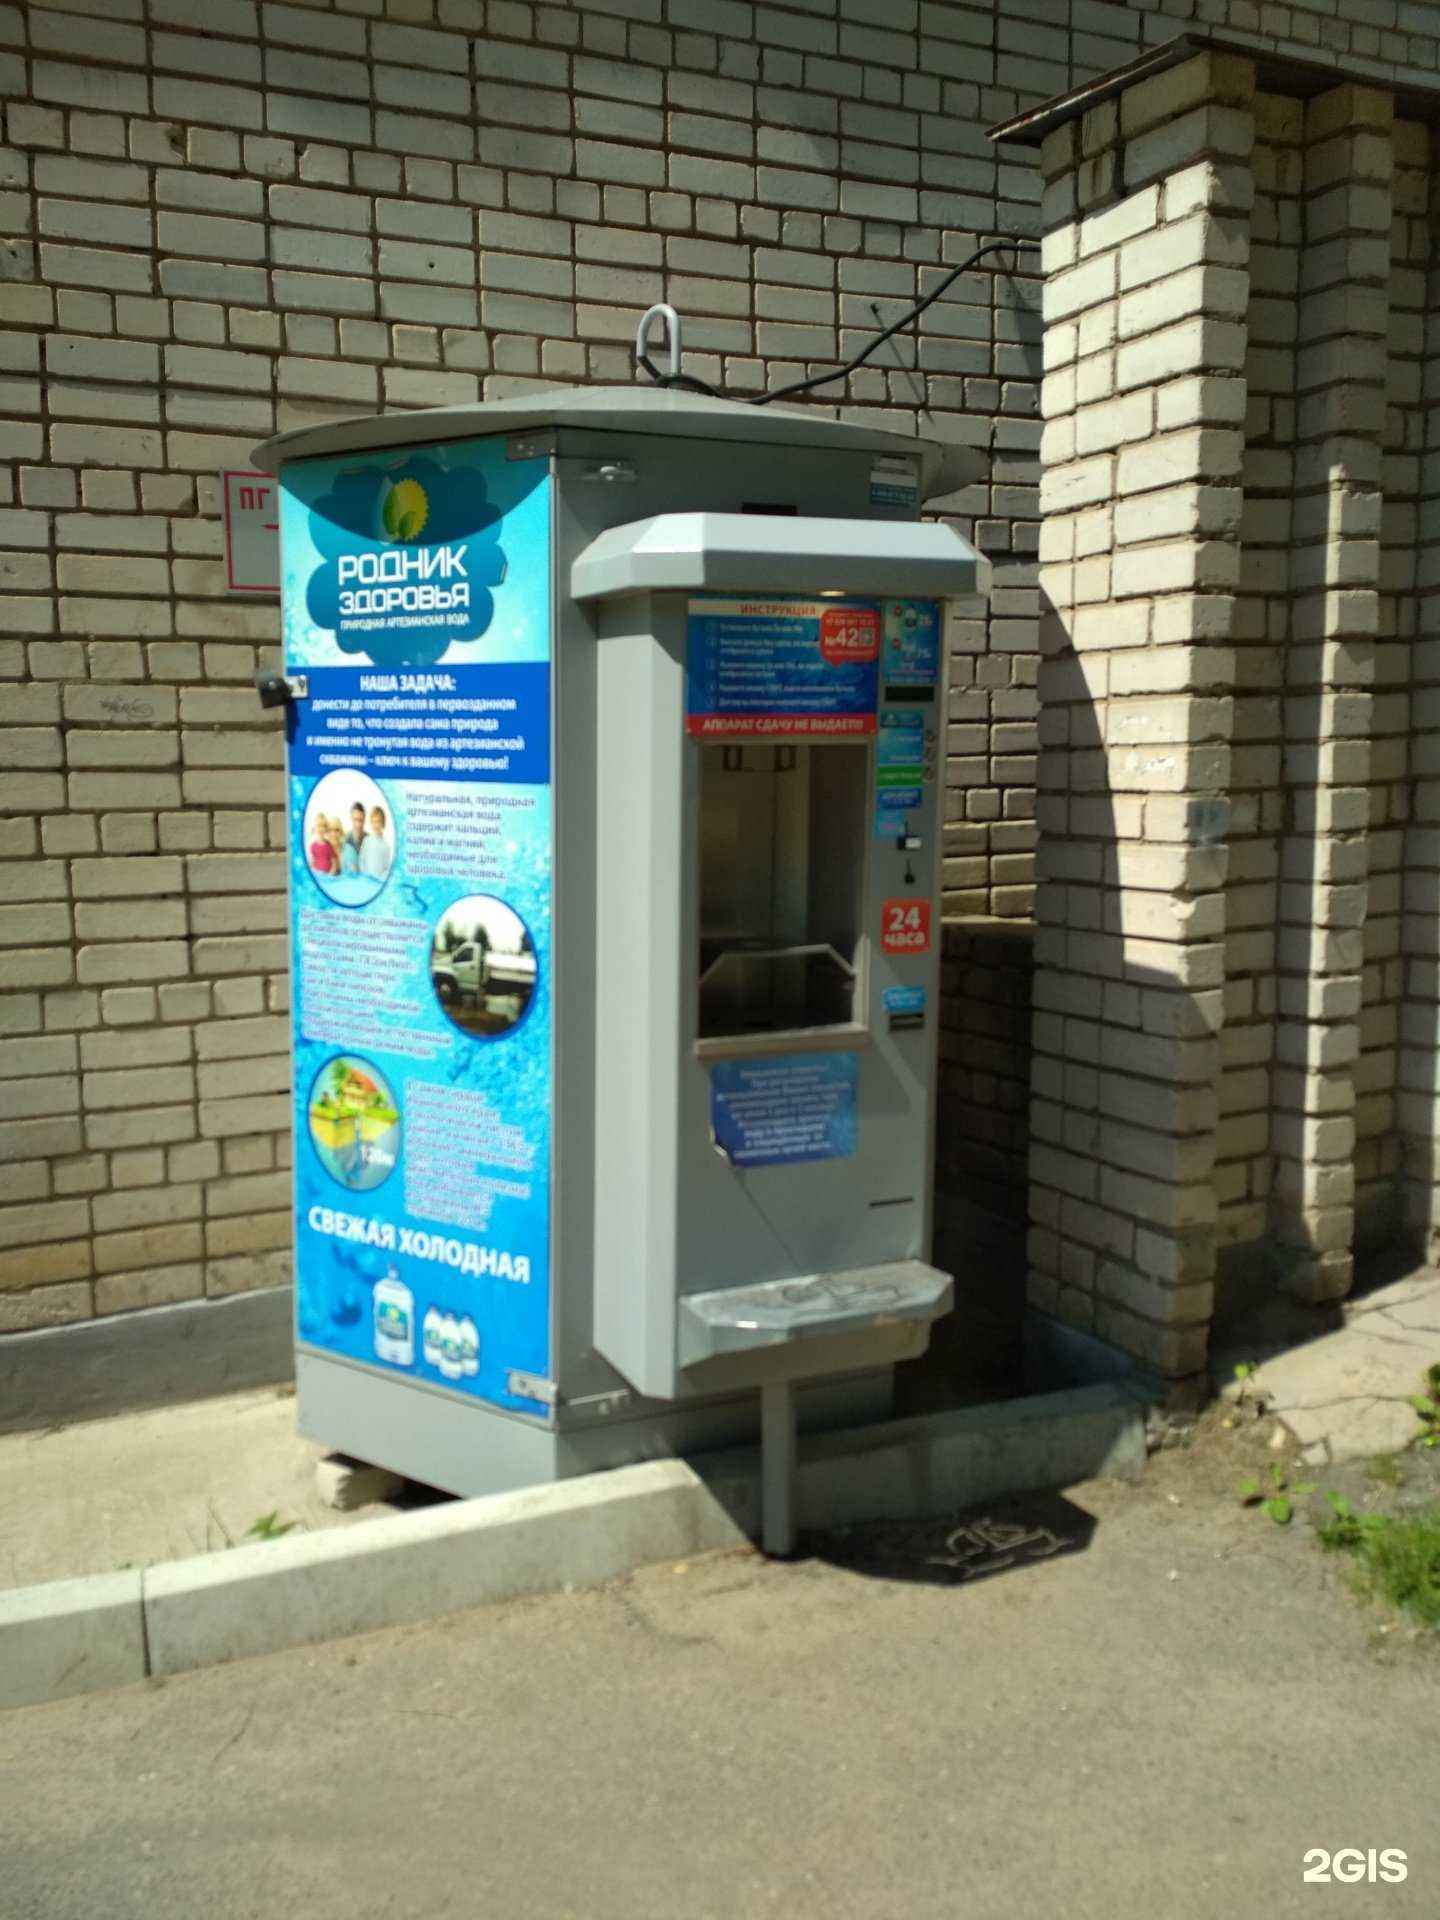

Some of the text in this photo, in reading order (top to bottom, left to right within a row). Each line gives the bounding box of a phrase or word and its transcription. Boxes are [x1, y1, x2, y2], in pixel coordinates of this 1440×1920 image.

[338, 544, 468, 586] РОДНИК
[339, 582, 470, 615] ЗДОРОВЬЯ
[740, 603, 816, 616] ИНСТРУКЦИЯ
[340, 613, 470, 630] ПРИРОДНАЯ АРТЕЗИАНСКАЯ ВОДА
[360, 675, 456, 694] НАША ЗАДАЧА:
[312, 700, 349, 712] донести
[351, 700, 363, 712] до
[365, 697, 427, 712] потребителя
[438, 699, 517, 713] первозданном
[327, 718, 350, 730] виде
[366, 718, 382, 729] что
[383, 718, 423, 730] создала
[425, 718, 450, 729] сама
[451, 718, 499, 732] природа
[704, 718, 754, 731] АППАРАТ
[757, 718, 792, 731] СДАЧУ
[794, 718, 810, 730] НЕ
[351, 736, 363, 747] не
[410, 737, 434, 750] вода
[435, 737, 449, 749] из
[450, 735, 525, 751] артезианской
[409, 756, 449, 771] вашему
[889, 906, 921, 931] 24
[884, 931, 925, 947] часа
[308, 1205, 531, 1284] СВЕЖАЯ ХОЛОДНАЯ
